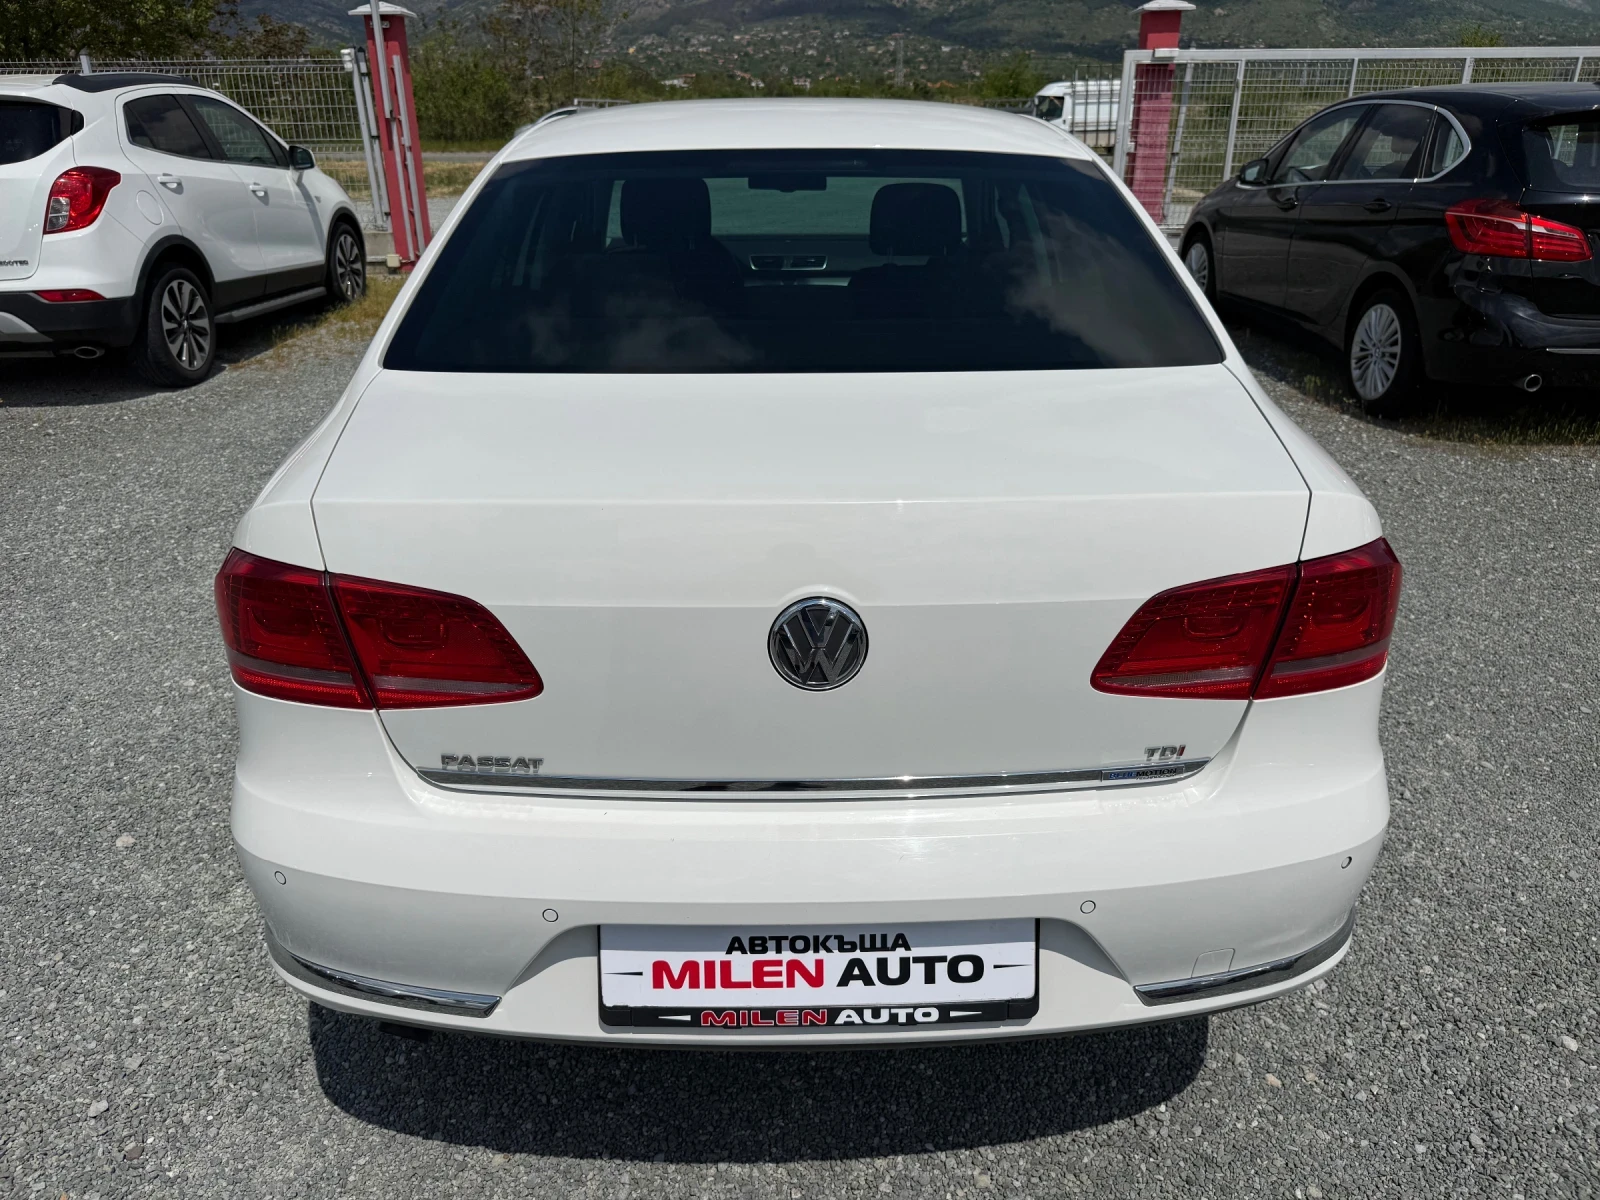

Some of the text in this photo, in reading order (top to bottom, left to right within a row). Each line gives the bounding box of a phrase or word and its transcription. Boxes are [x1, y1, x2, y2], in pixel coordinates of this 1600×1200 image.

[441, 753, 544, 774] PASSAT
[1144, 745, 1186, 762] TDI
[651, 953, 985, 989] MILEN AUTO
[700, 1006, 940, 1027] MILEN AUTO
